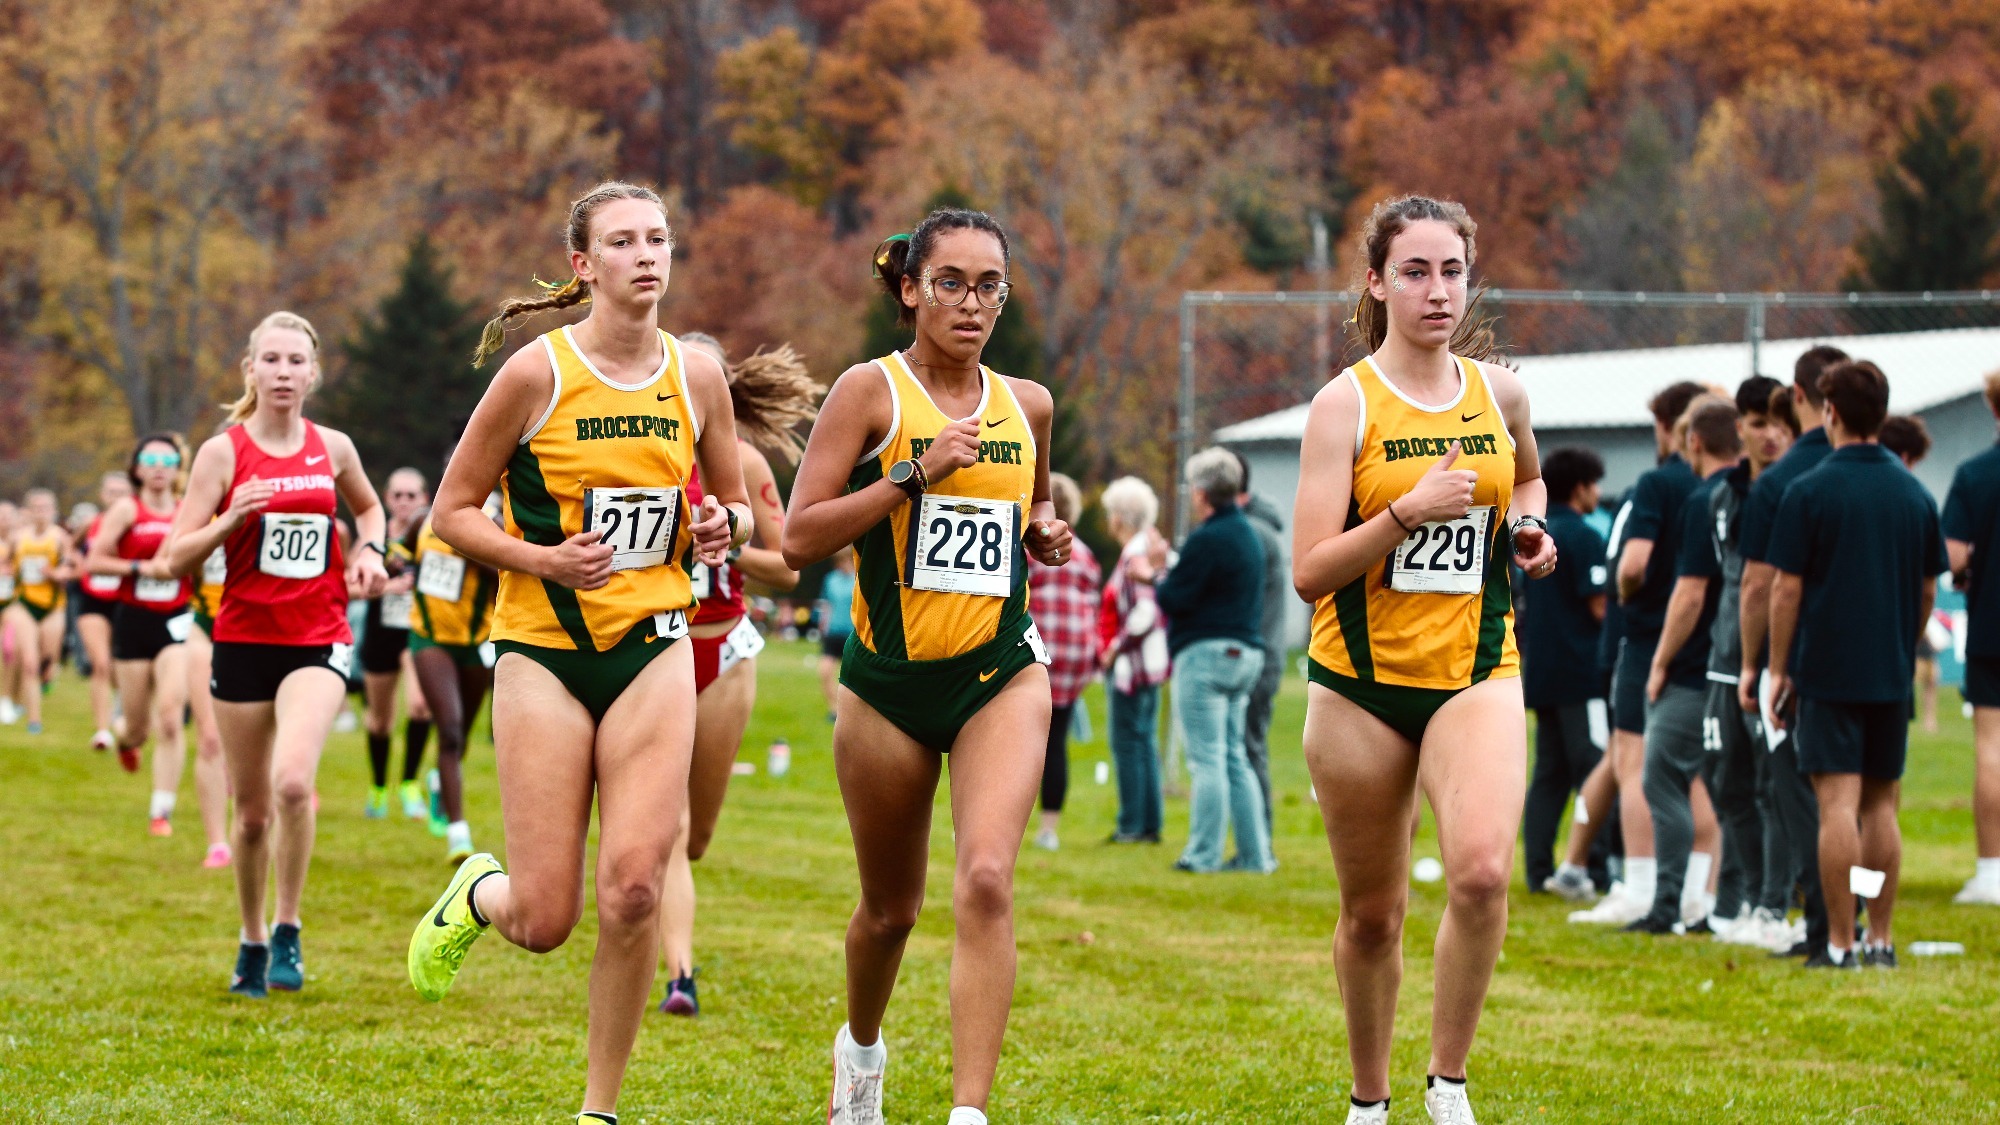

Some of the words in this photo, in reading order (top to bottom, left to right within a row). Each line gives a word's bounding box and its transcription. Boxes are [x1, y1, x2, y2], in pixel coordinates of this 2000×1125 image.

[576, 415, 679, 441] BROCKPORT
[911, 438, 1021, 465] BPORT
[269, 528, 319, 561] 302
[599, 506, 668, 552] 217
[926, 517, 1003, 571] 228
[1404, 525, 1476, 571] 229
